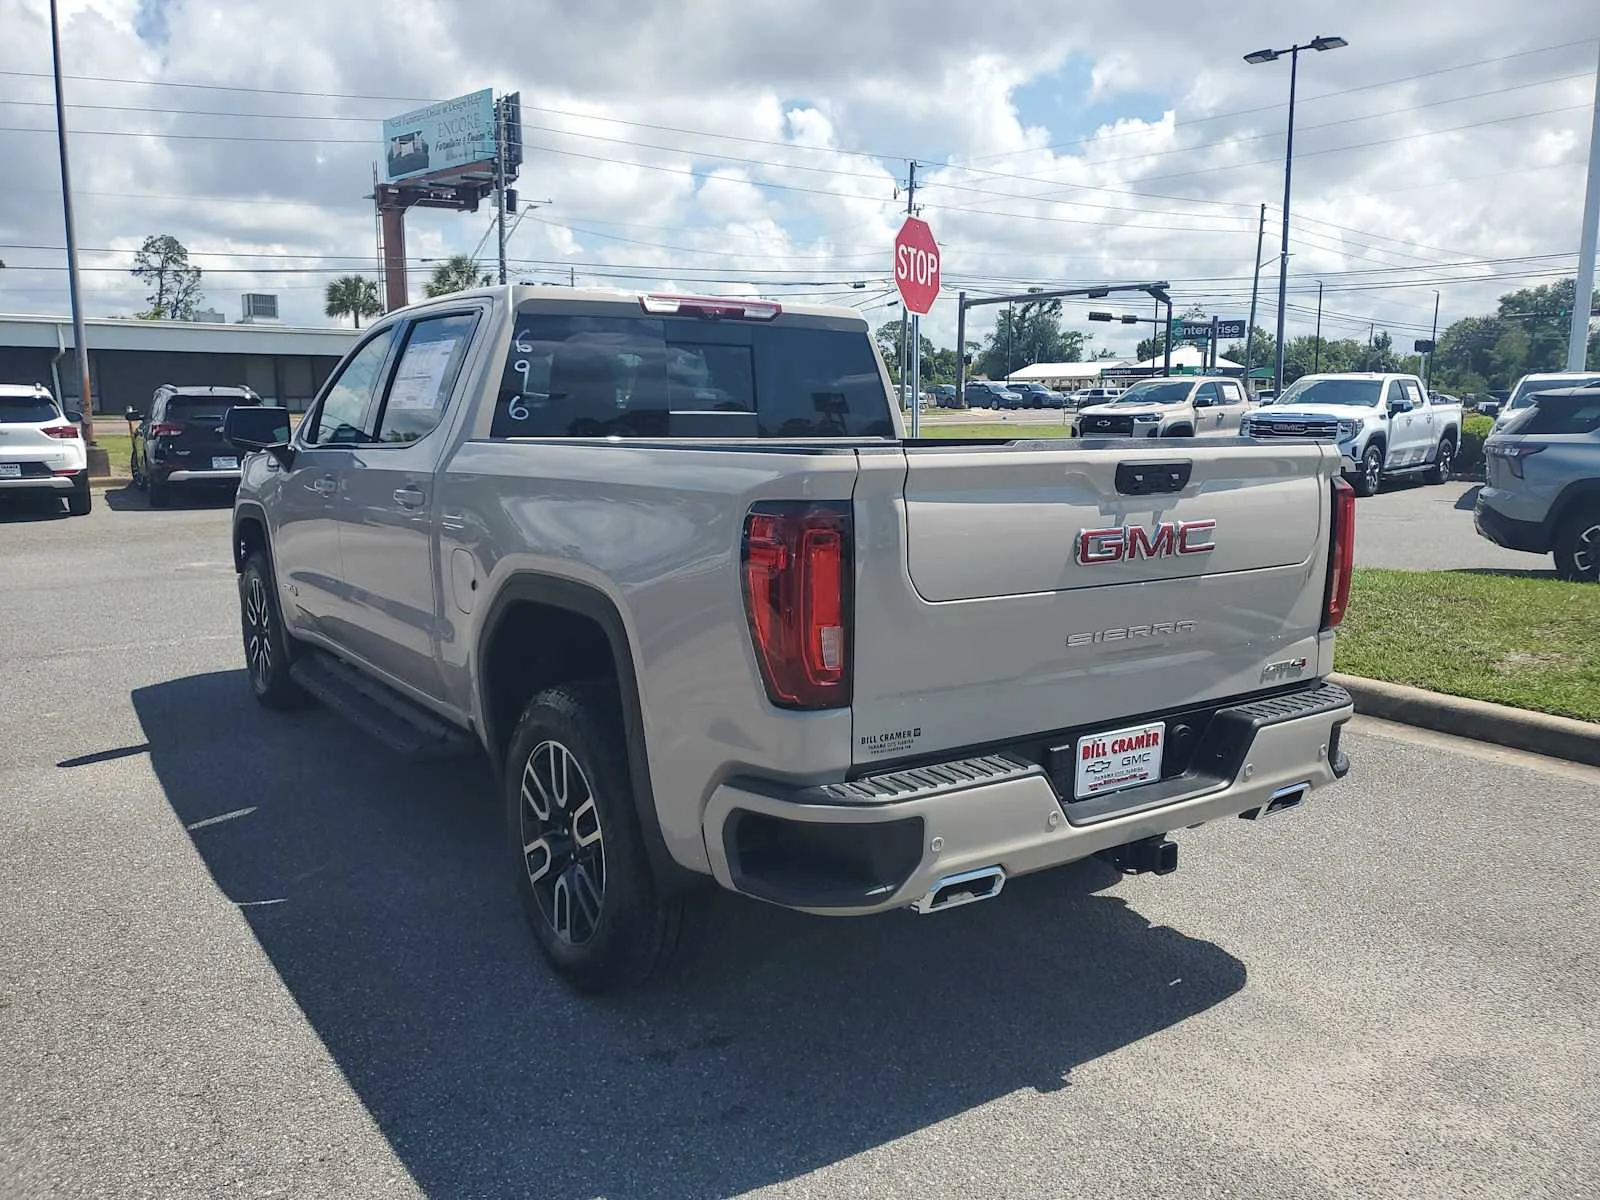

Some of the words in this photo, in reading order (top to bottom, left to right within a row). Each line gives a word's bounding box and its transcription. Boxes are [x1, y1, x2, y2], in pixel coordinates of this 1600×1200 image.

[898, 244, 937, 286] STOP
[1272, 423, 1306, 432] GMC
[1075, 519, 1216, 566] GMC
[1066, 620, 1198, 648] SIERRA
[861, 735, 877, 745] BILL
[880, 730, 912, 742] CRAMER
[1082, 742, 1107, 760] BILL
[1111, 732, 1159, 754] CRAMER
[1121, 752, 1151, 766] GMC
